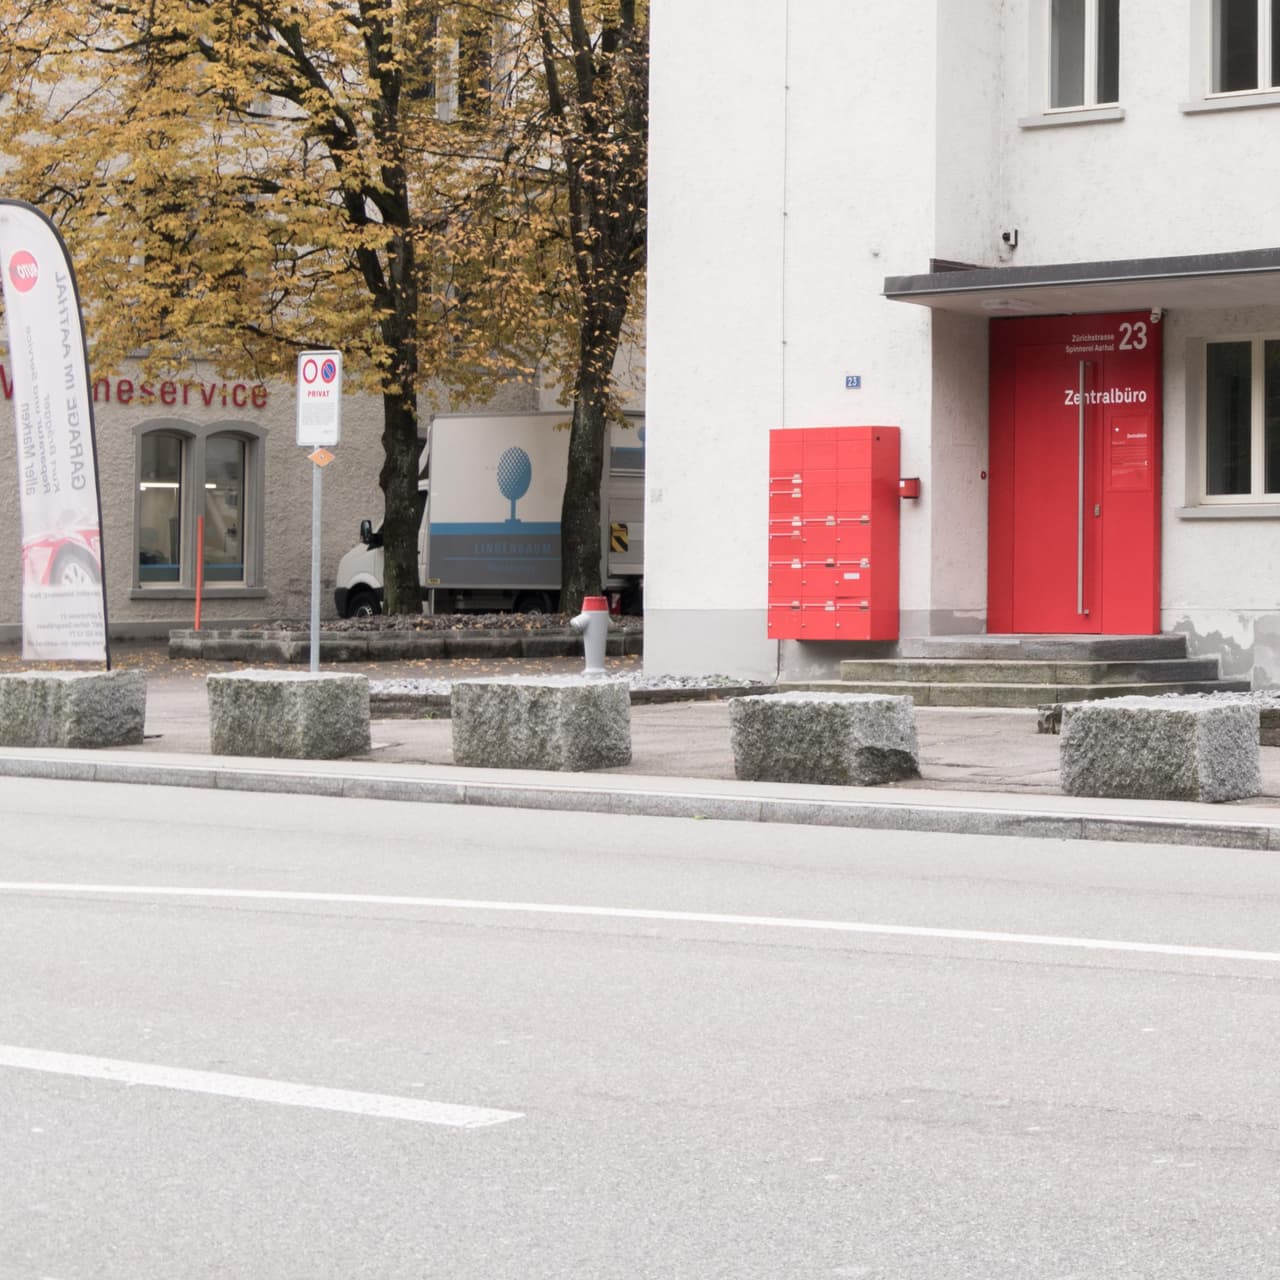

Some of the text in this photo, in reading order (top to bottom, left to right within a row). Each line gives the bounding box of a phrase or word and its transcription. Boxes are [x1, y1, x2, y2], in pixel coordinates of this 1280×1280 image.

[1119, 322, 1148, 351] 23
[307, 390, 330, 398] PRIVAT
[1064, 388, 1147, 406] Zentralbüro
